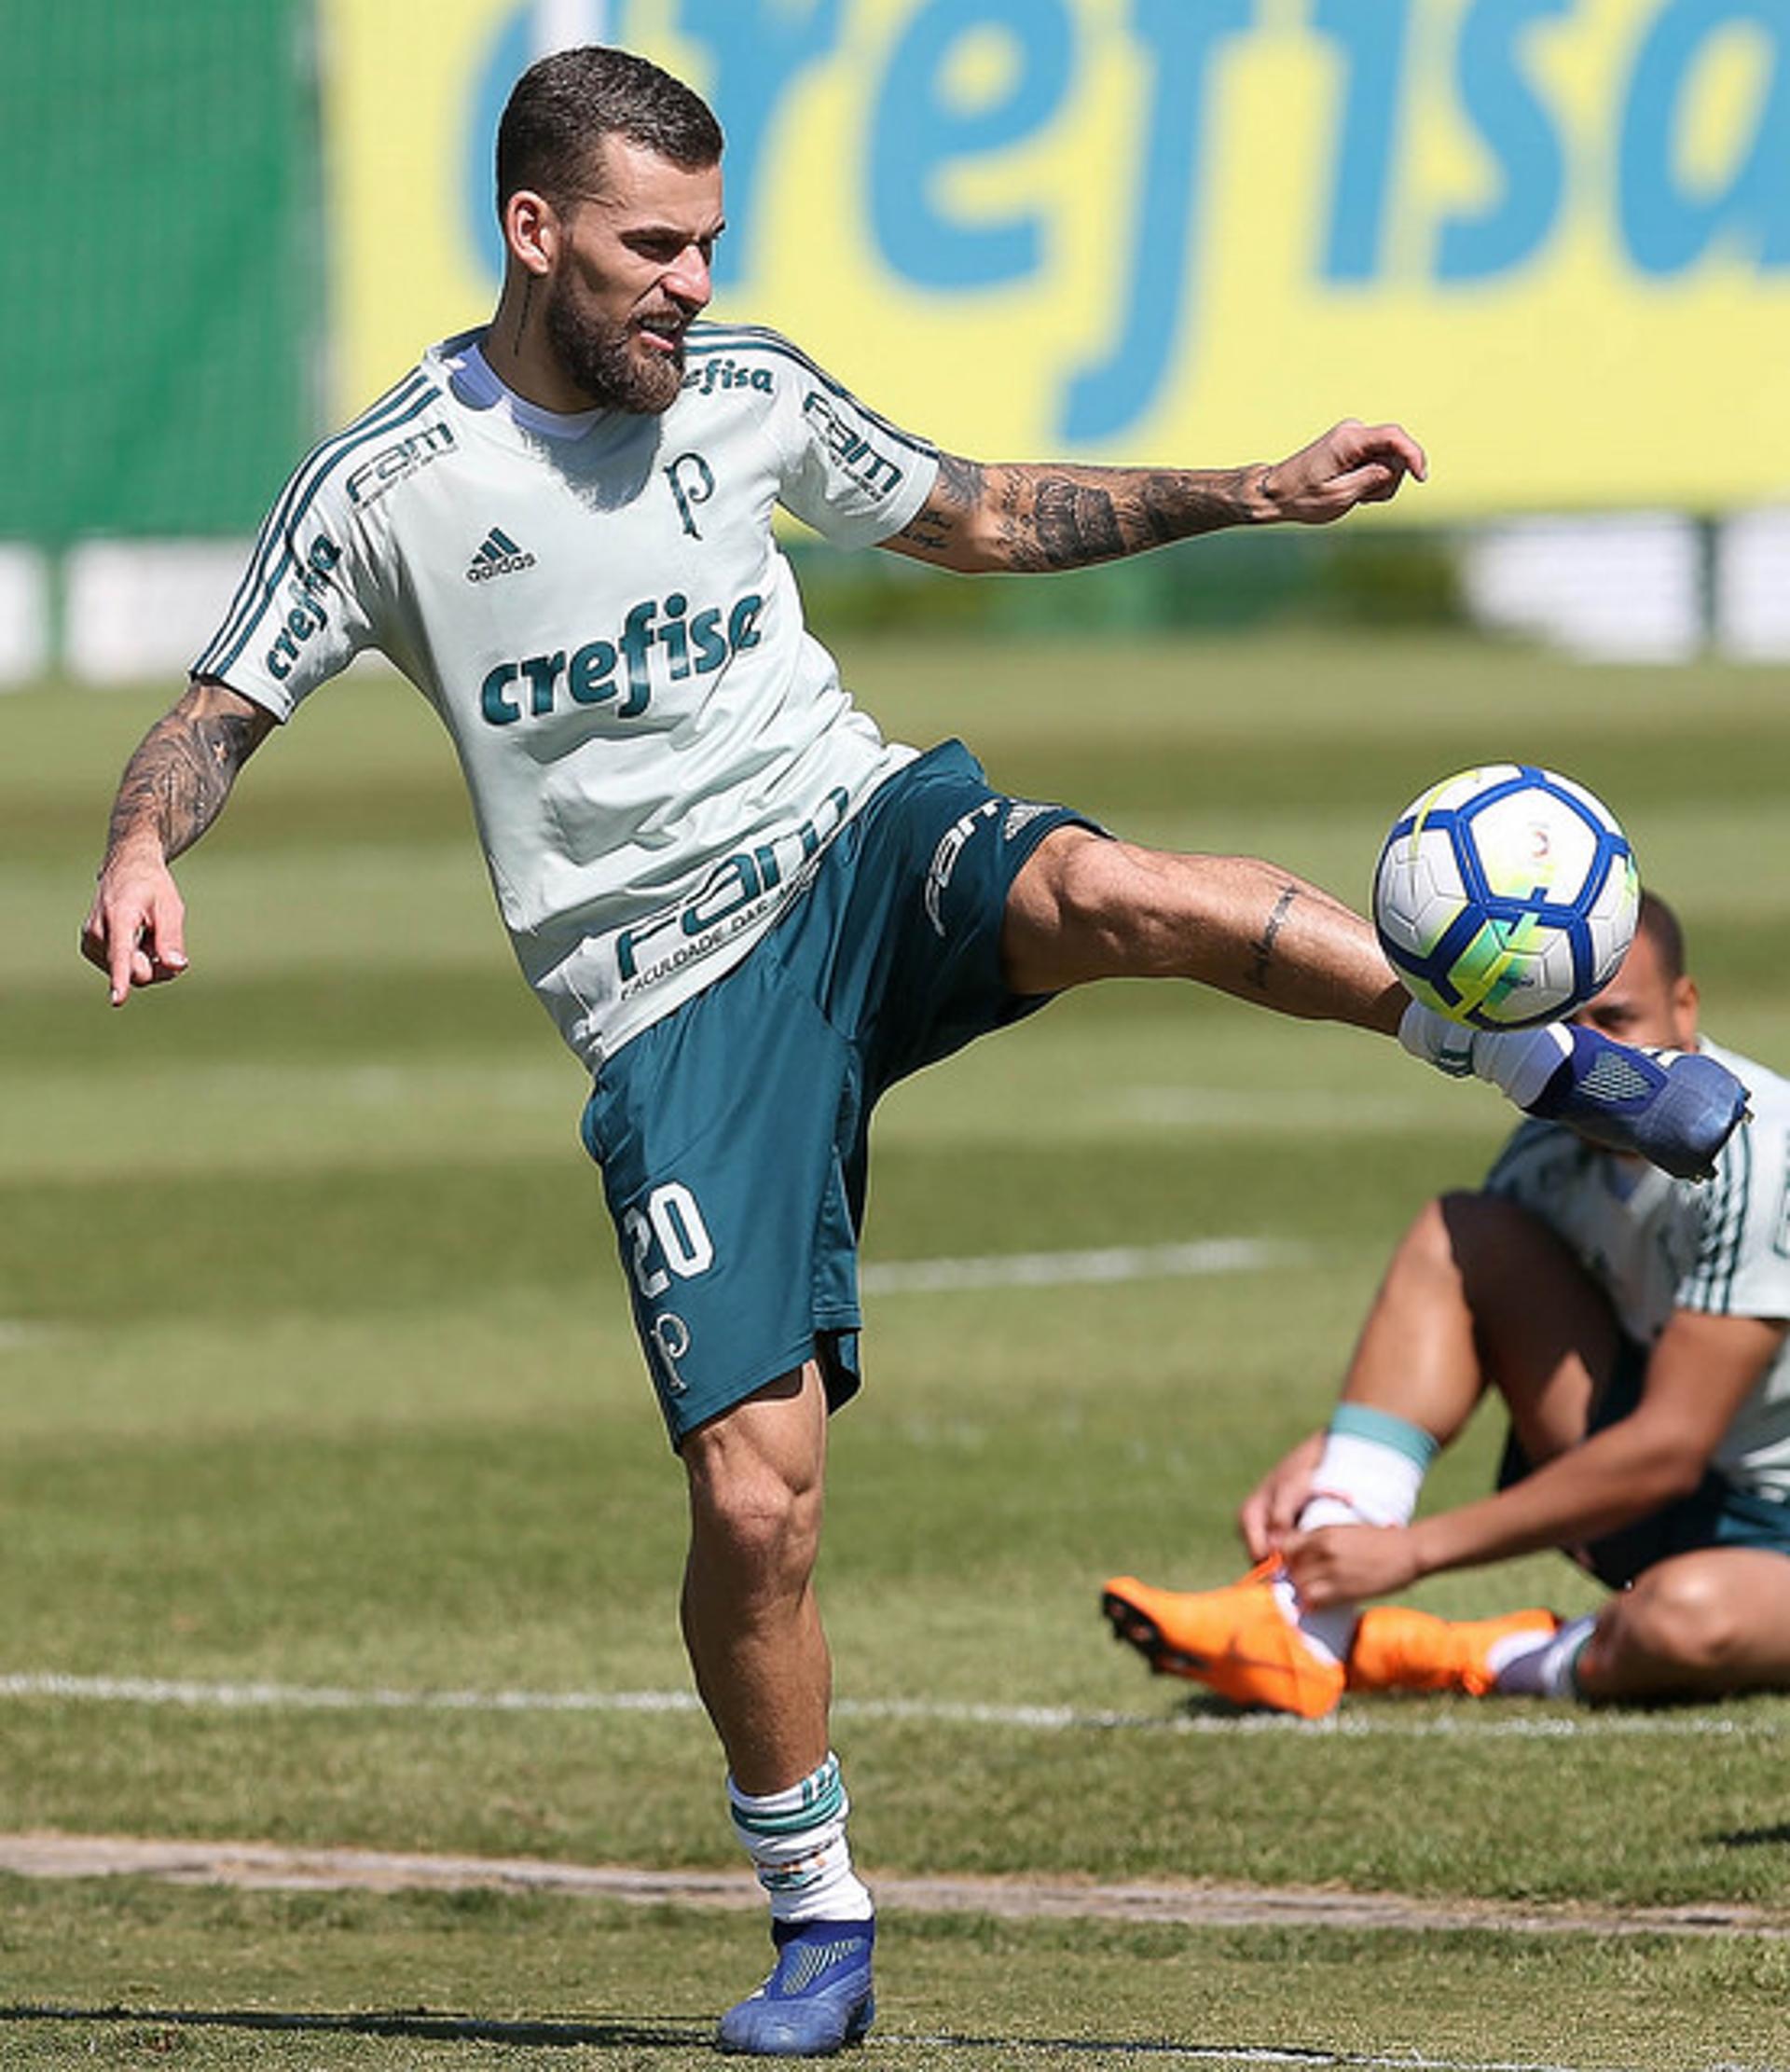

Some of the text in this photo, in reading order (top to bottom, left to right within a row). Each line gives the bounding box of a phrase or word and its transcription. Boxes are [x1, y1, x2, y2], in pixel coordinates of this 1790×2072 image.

[459, 0, 1790, 446] refisa
[682, 357, 775, 395] efisa
[267, 533, 343, 681] crefia
[466, 552, 537, 583] adidas
[624, 1181, 714, 1299] 20
